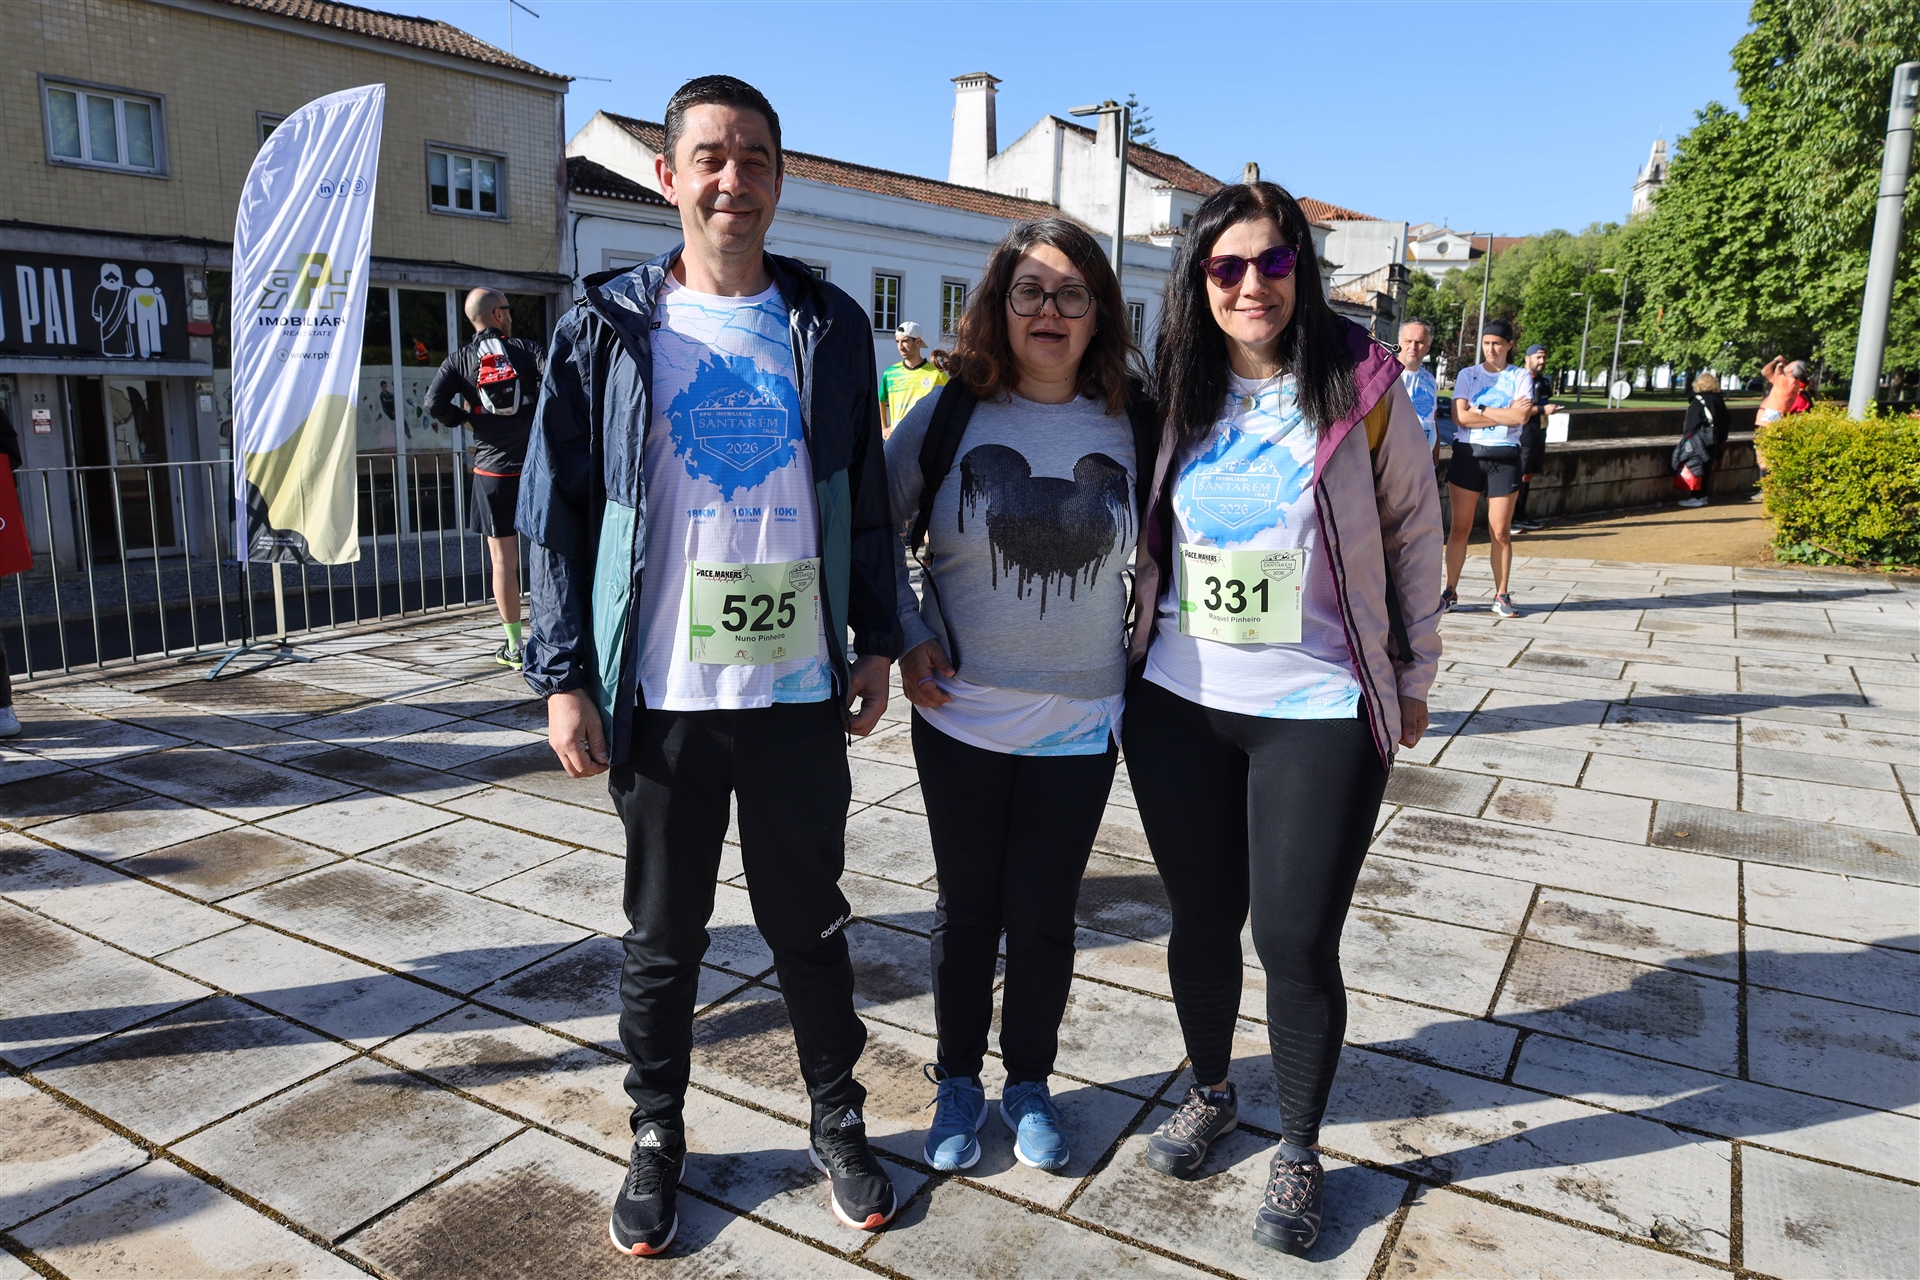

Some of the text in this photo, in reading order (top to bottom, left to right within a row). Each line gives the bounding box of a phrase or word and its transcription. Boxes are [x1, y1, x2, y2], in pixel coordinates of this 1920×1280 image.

[15, 265, 78, 345] PAI
[258, 314, 346, 327] IMOBILIÁR
[698, 415, 779, 429] SANTARÉM
[726, 442, 759, 454] 2026
[1198, 481, 1272, 492] SANTARÉM
[687, 508, 716, 518] 18KM
[732, 507, 761, 517] 10KM
[1219, 503, 1249, 515] 2026
[1204, 576, 1269, 614] 331
[721, 591, 796, 632] 525
[1208, 612, 1229, 623] Raquel
[735, 633, 786, 642] Nuno Pinheiro
[820, 914, 845, 939] adidas
